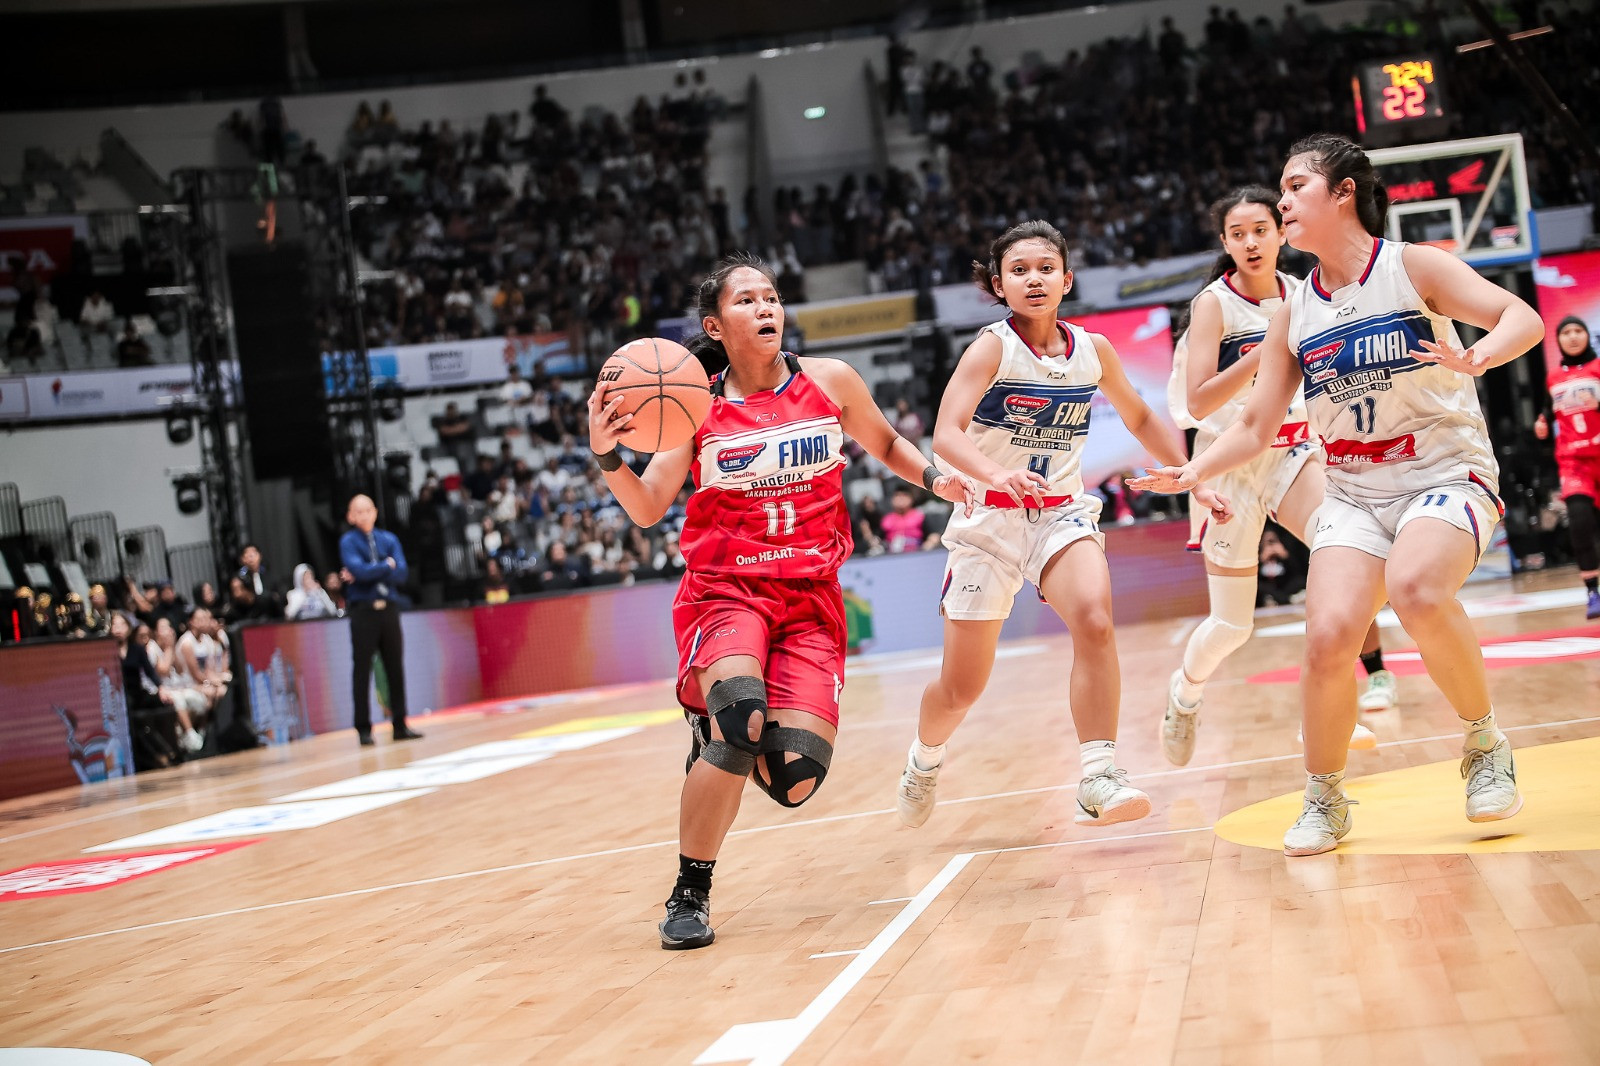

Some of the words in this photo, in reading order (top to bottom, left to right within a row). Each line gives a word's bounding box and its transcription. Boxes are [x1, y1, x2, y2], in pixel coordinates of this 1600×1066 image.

[1382, 83, 1426, 121] 22
[1312, 348, 1334, 359] HONDA
[1354, 329, 1413, 367] FINAL
[1327, 369, 1386, 393] BULUNGAN
[1348, 395, 1377, 435] 11
[1018, 427, 1071, 440] BULUNGAN
[727, 449, 755, 458] HONDA
[778, 433, 831, 469] FINAL
[751, 472, 804, 489] PHOENIX
[745, 489, 776, 498] JAKARTA
[1421, 494, 1450, 507] 11
[762, 500, 796, 536] 11
[736, 555, 757, 566] One
